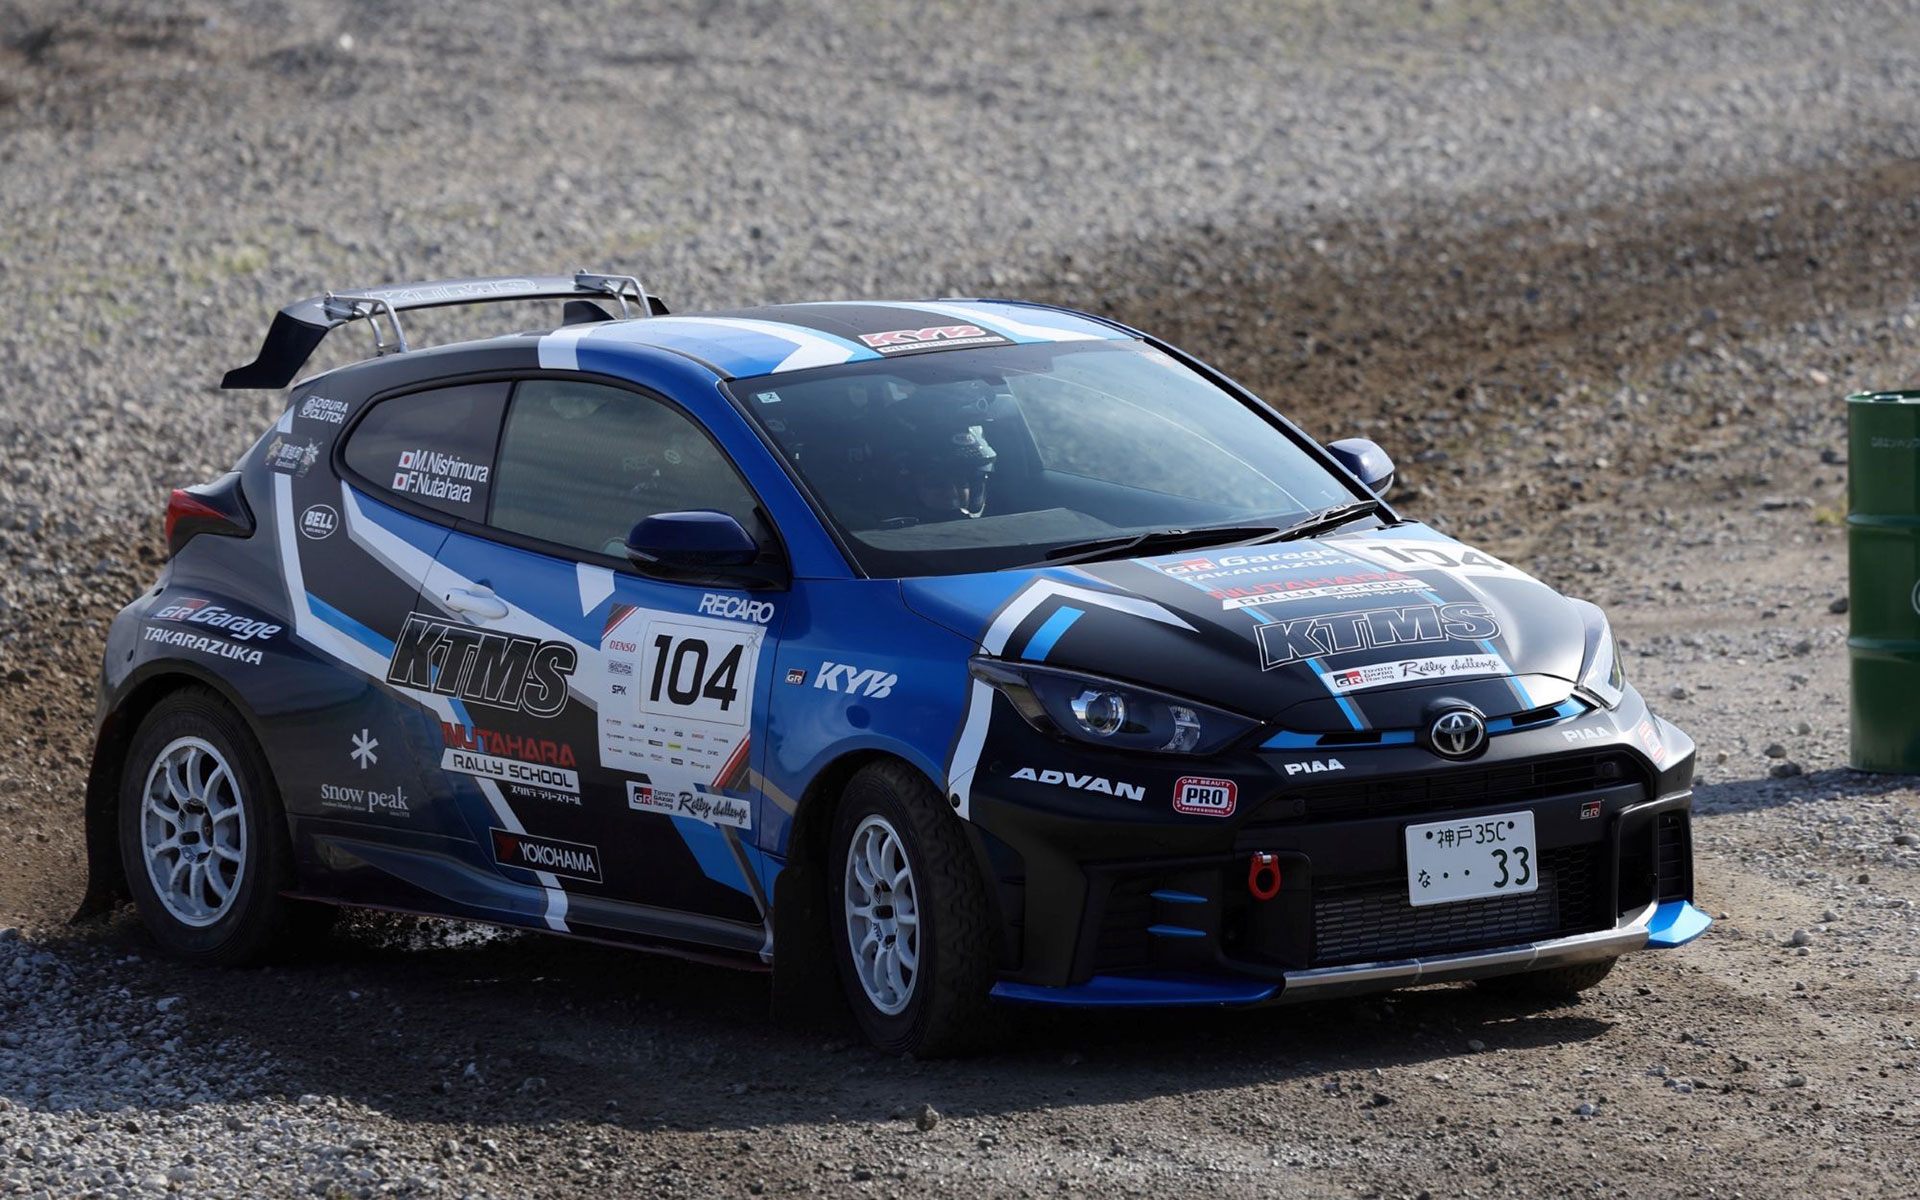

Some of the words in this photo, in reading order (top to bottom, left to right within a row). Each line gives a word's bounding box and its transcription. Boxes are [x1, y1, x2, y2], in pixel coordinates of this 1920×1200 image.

[858, 325, 986, 348] KYB
[310, 408, 345, 424] CLUTCH
[315, 398, 349, 414] OGURA
[411, 449, 489, 483] M.Nishimura
[405, 472, 471, 503] F.Nutahara
[304, 510, 334, 529] BELL
[1164, 561, 1217, 576] GR
[1218, 549, 1340, 567] Garage
[1178, 558, 1362, 582] TAKARAZUKA
[1384, 545, 1505, 572] 104
[1207, 571, 1412, 600] NUTAHARA
[1236, 589, 1317, 606] RALLY
[1329, 579, 1420, 596] SCHOOL
[698, 593, 775, 624] RECARO
[157, 606, 193, 618] GR
[189, 606, 281, 640] Garage
[144, 627, 264, 665] TAKARAZUKA
[609, 640, 637, 653] DENSO
[1253, 602, 1501, 672] KTMS
[386, 611, 577, 718] KTMS
[650, 634, 744, 711] 104
[1398, 661, 1447, 677] Rally
[1450, 657, 1499, 671] challenge
[611, 684, 627, 696] SPK
[786, 674, 802, 684] GR
[813, 661, 898, 699] KYB
[1335, 675, 1363, 688] GR
[441, 722, 576, 767] NUTAHARA
[1561, 726, 1613, 743] PIAA
[452, 753, 505, 776] RALLY
[508, 765, 574, 789] SCHOOL
[1284, 758, 1346, 776] PIAA
[1010, 767, 1146, 801] ADVAN
[1186, 788, 1223, 806] PRO
[1200, 780, 1231, 788] BEAUTY
[320, 783, 364, 803] snow
[367, 786, 409, 813] peak
[634, 793, 652, 806] GR
[678, 791, 711, 819] Rally
[1581, 807, 1600, 818] GR
[518, 841, 597, 874] YOKOHAMA
